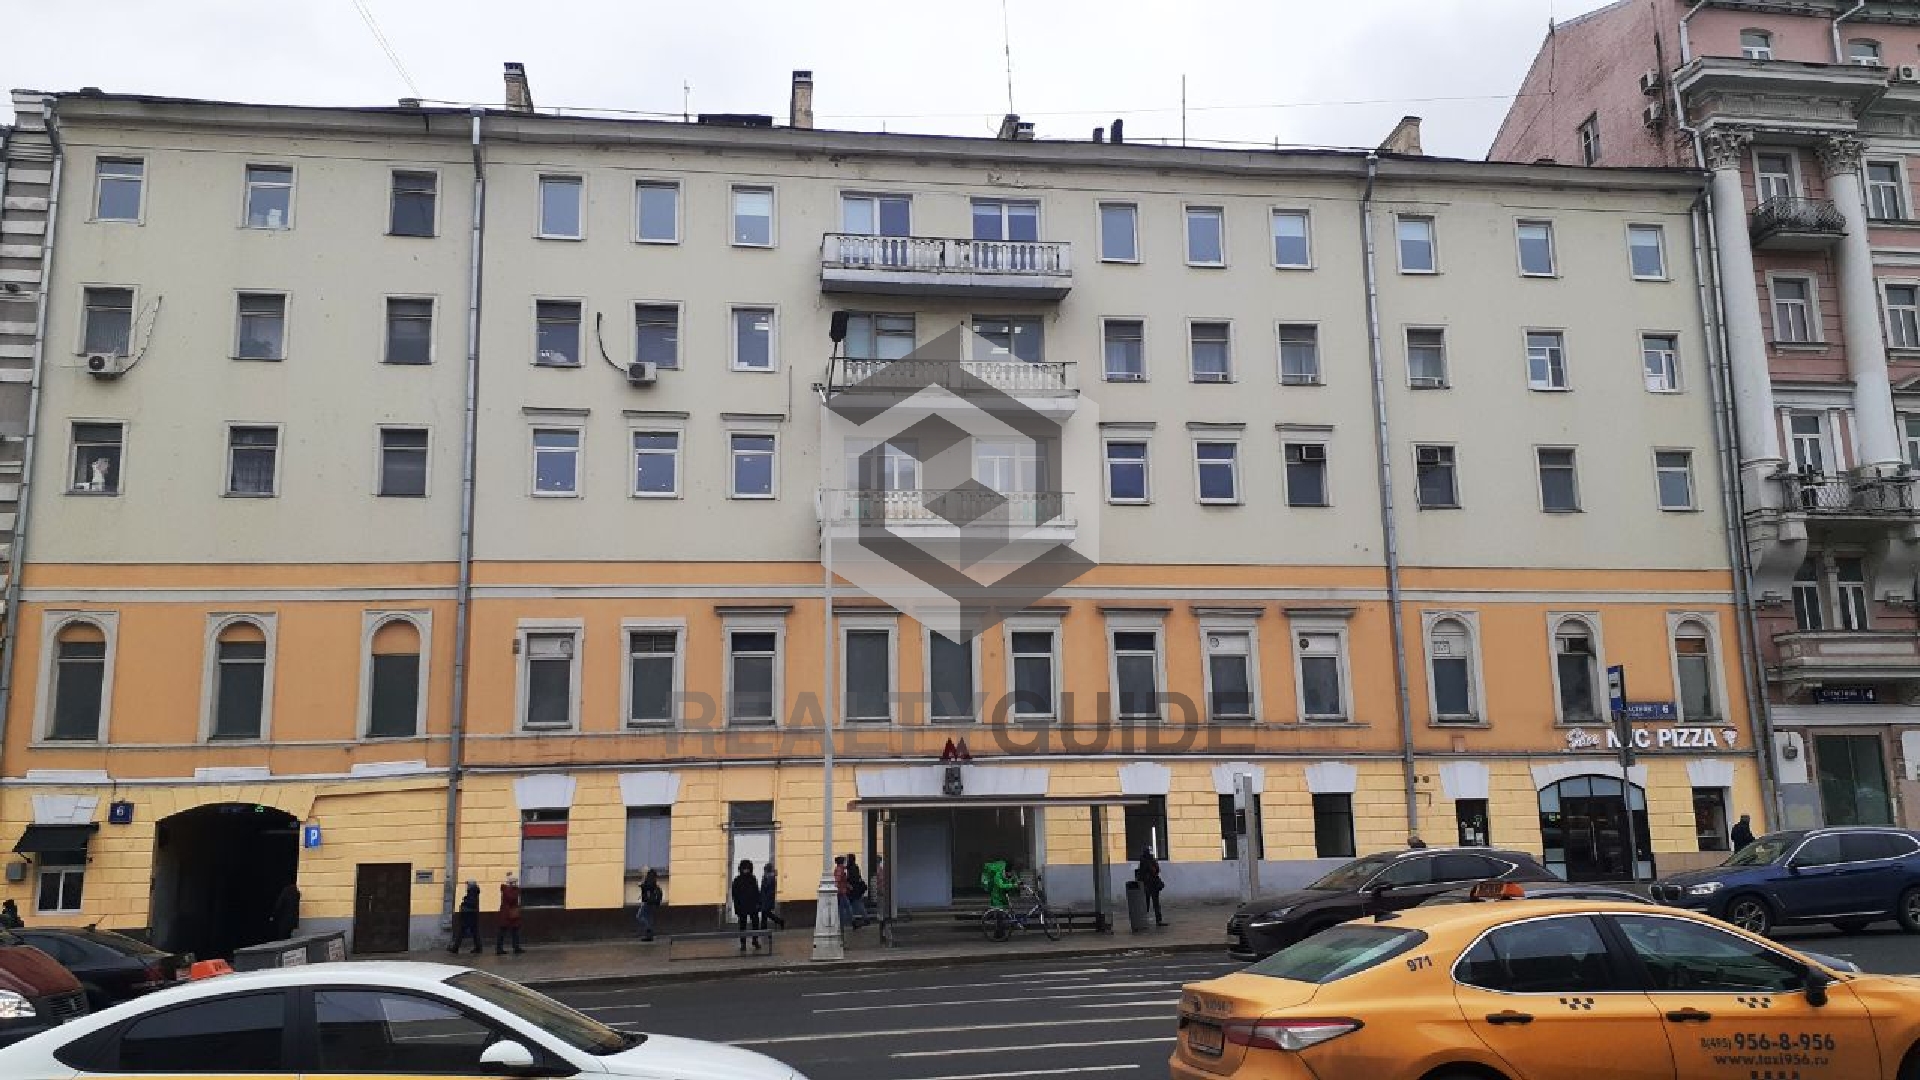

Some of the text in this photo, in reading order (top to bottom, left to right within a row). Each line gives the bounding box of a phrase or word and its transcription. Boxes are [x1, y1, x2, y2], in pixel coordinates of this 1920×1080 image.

[1866, 689, 1873, 700] 4
[1662, 704, 1669, 714] 6
[1659, 728, 1717, 747] PIZZA
[116, 804, 126, 816] 6
[310, 829, 318, 845] P
[1405, 955, 1433, 972] 971
[1734, 1032, 1836, 1051] 956-8-956
[1714, 1054, 1829, 1066] www.taxi956.ru
